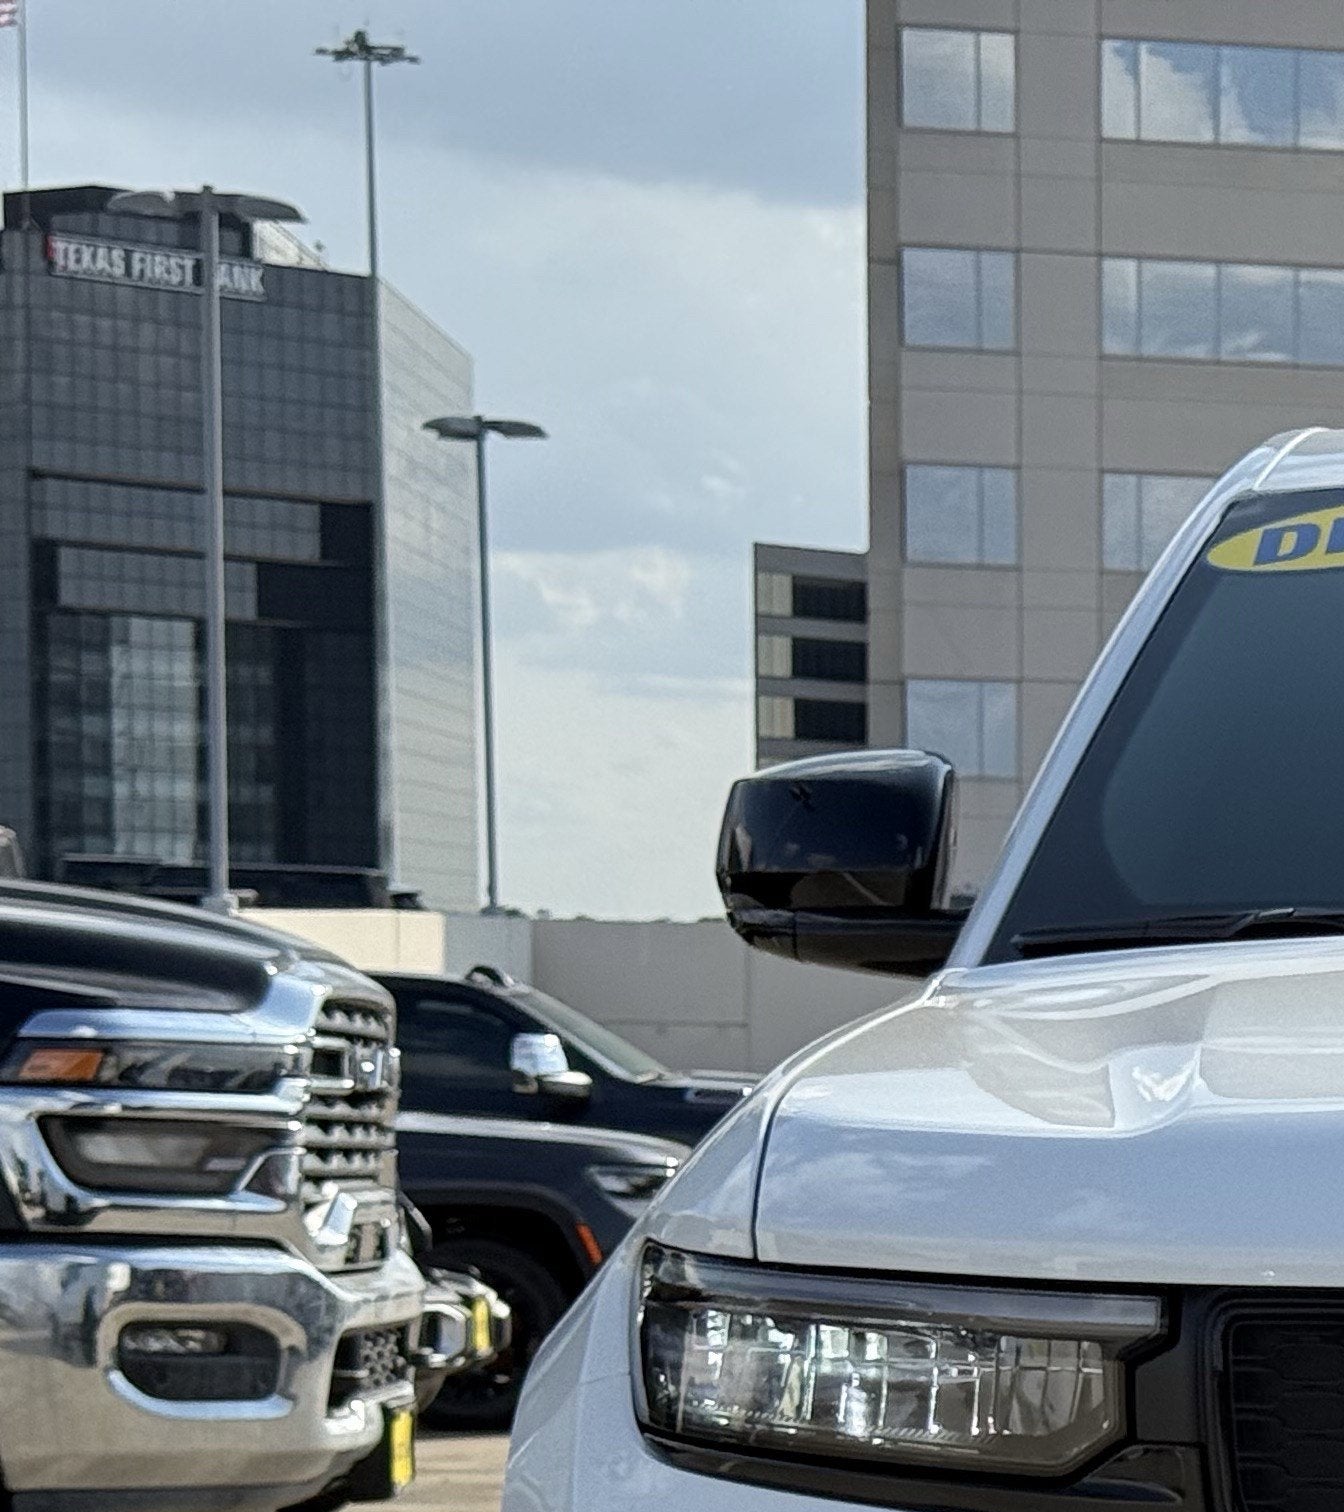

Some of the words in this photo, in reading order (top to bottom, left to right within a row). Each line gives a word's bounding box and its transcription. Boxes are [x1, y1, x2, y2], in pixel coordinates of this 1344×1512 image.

[54, 239, 126, 277] TEXAS
[131, 250, 196, 287] FIRST
[215, 262, 265, 293] ANK
